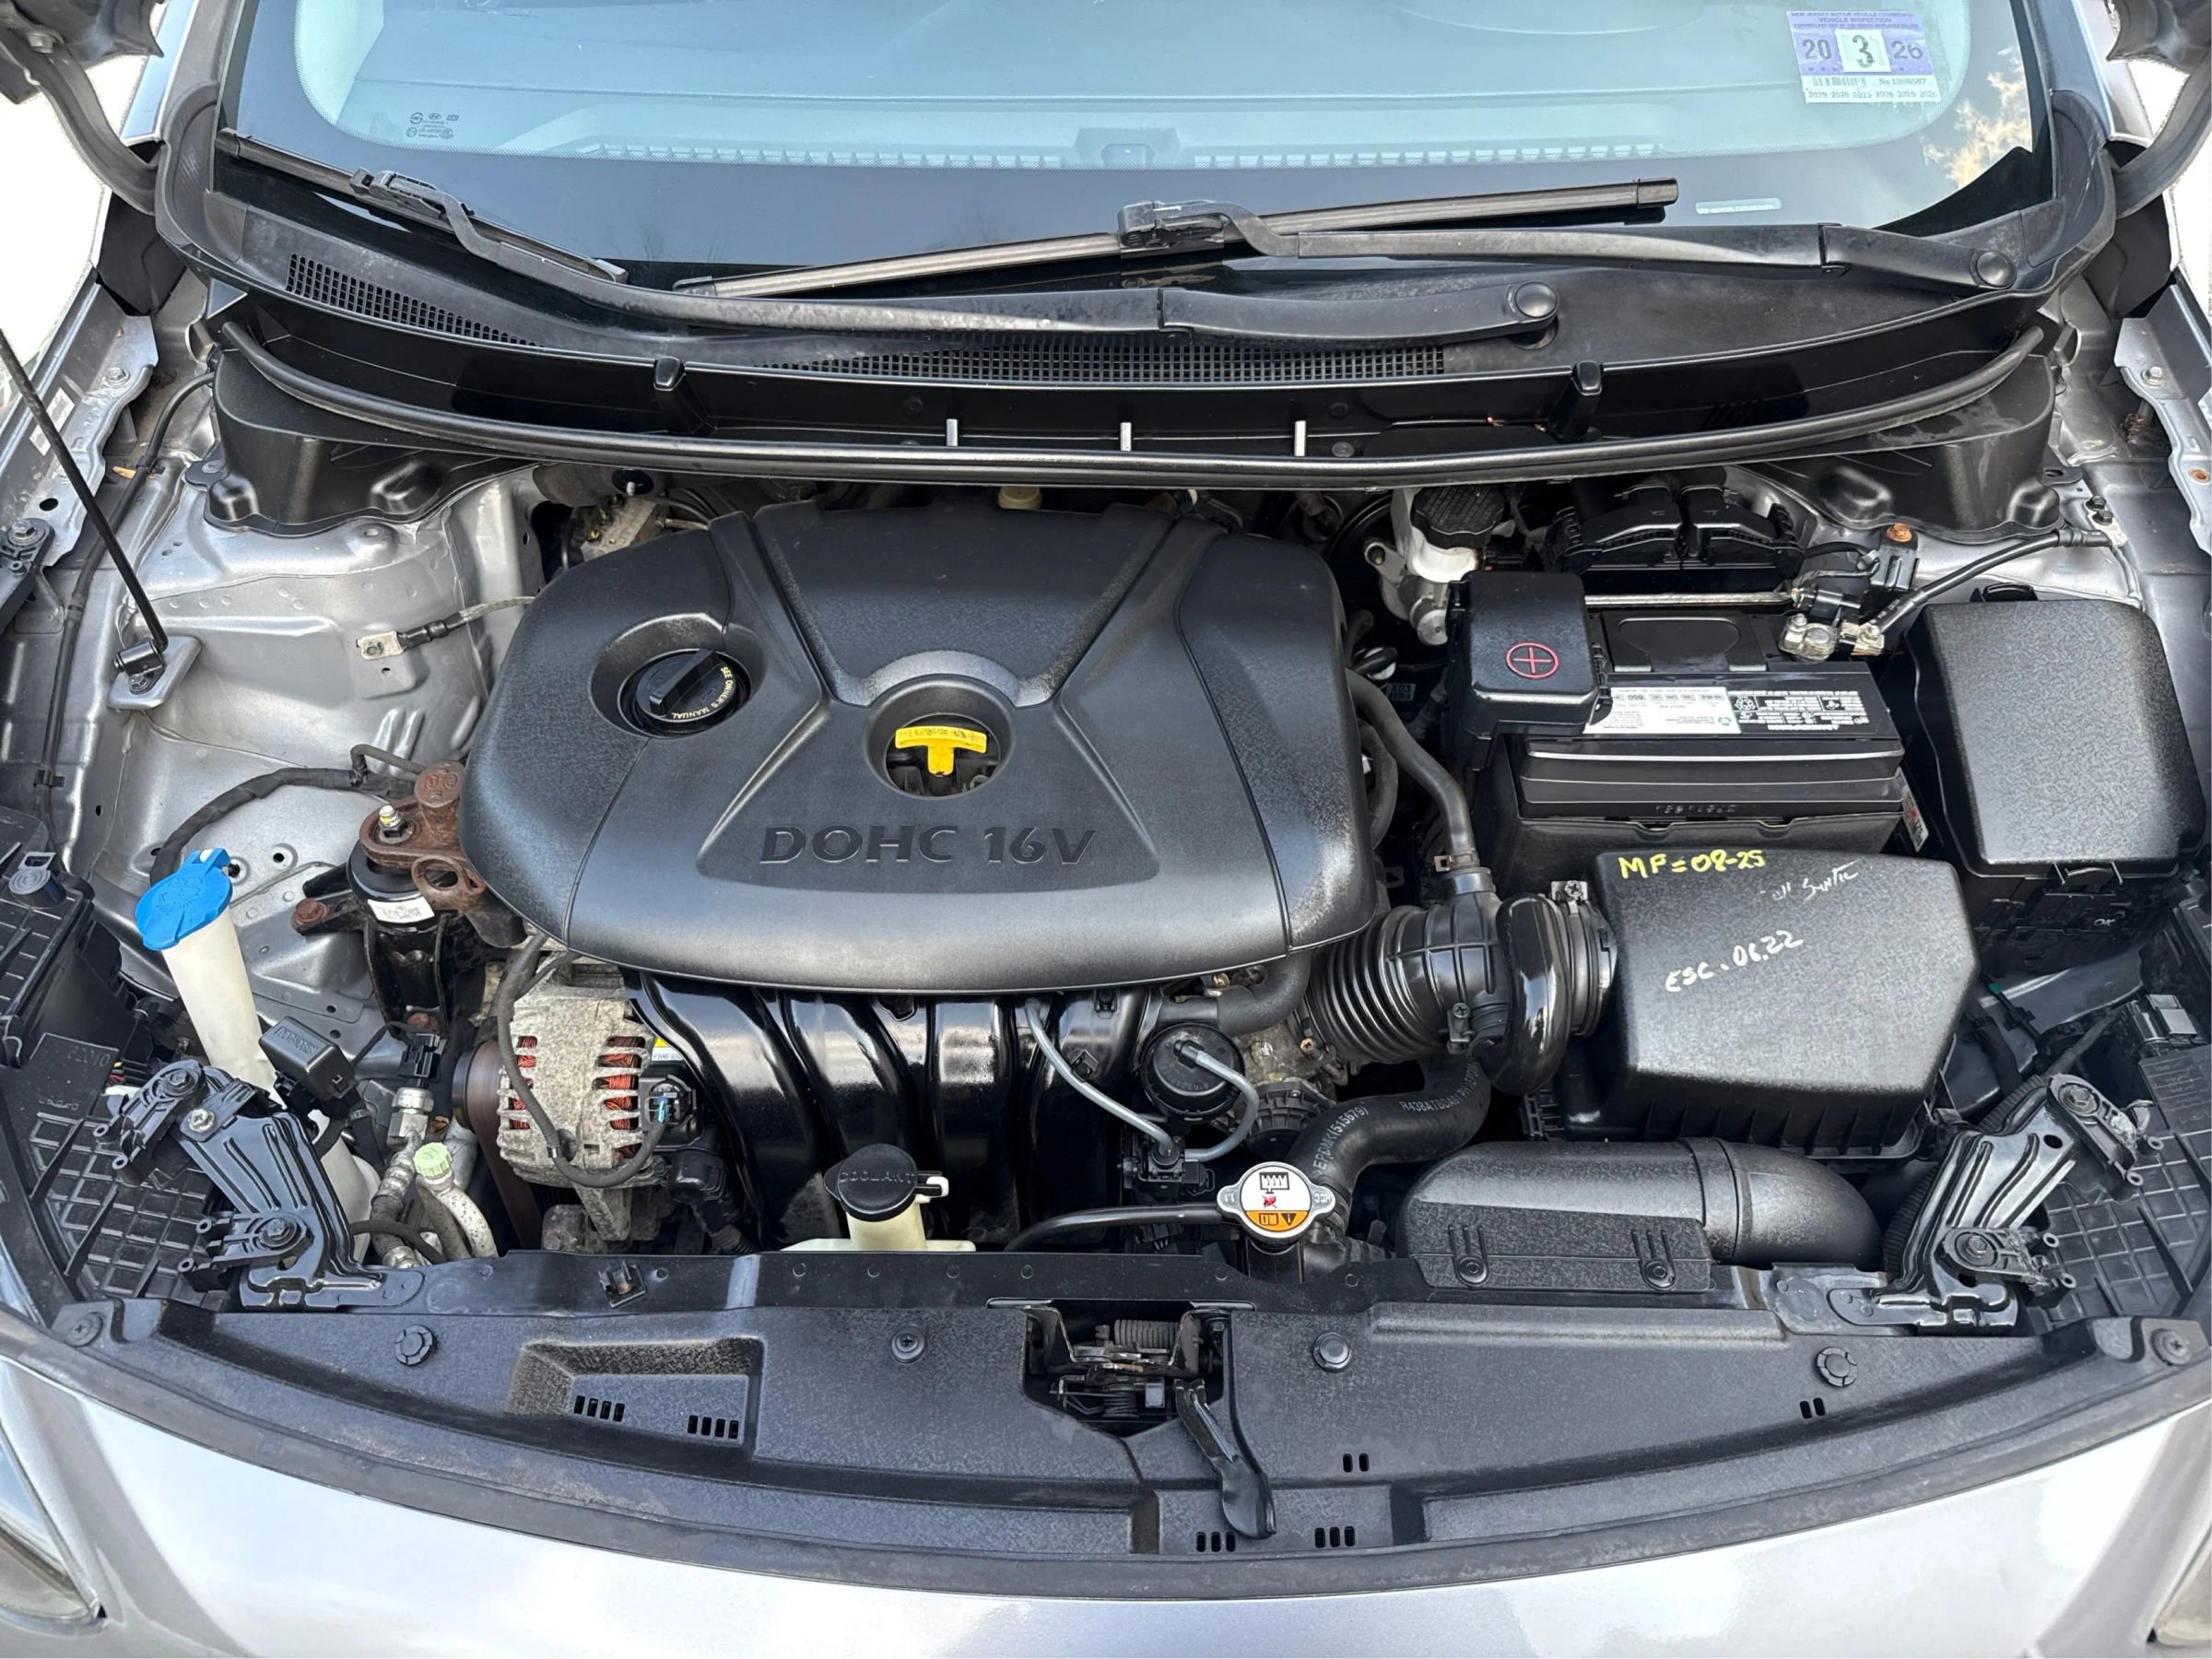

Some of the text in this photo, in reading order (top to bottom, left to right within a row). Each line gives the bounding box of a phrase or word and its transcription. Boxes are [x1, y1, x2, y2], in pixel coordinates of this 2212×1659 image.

[1802, 34, 1924, 68] 20 3 26
[671, 665, 735, 720] SEE OWNER'S MANUAL
[759, 823, 1098, 865] DOHC 16V
[839, 1171, 914, 1184] COOLANT
